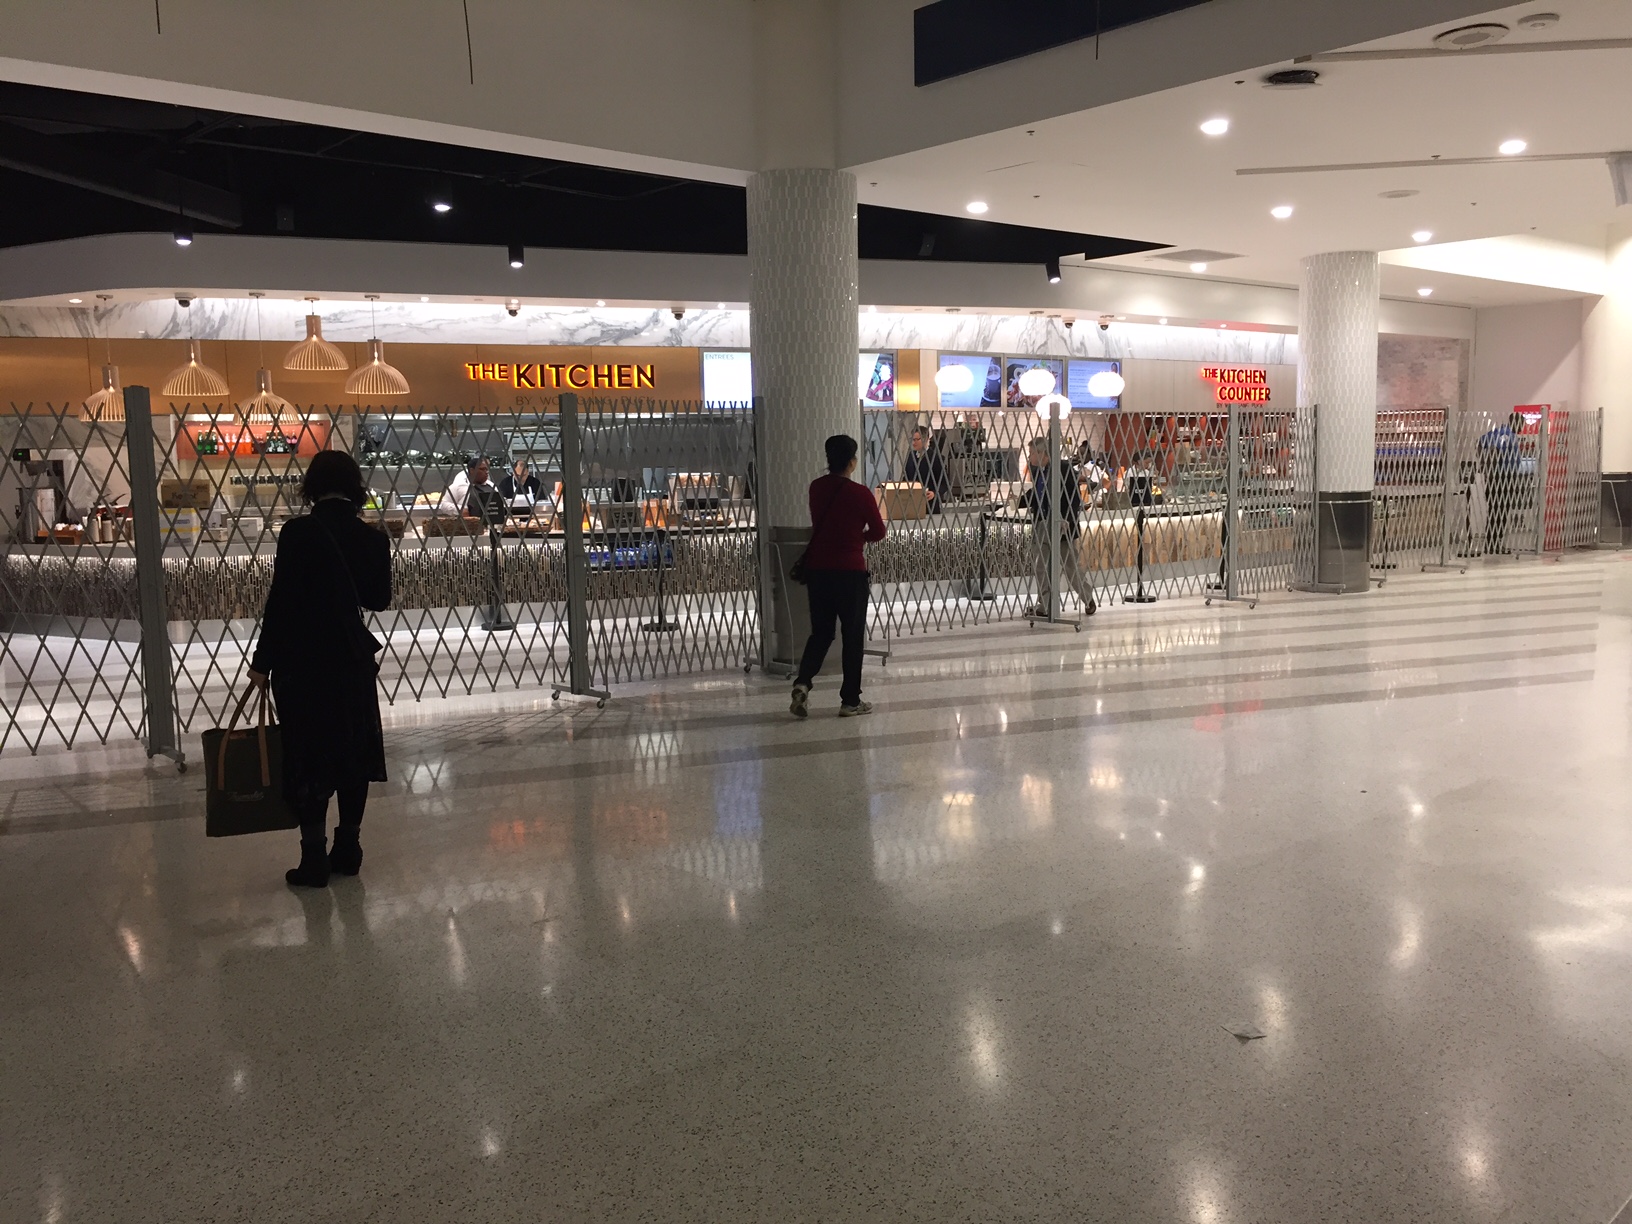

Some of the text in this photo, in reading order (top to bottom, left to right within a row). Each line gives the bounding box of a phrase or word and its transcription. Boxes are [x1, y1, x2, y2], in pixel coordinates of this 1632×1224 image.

[704, 353, 735, 361] ENTREES
[466, 363, 655, 389] THE KITCHEN
[1203, 368, 1266, 384] THE KITCHEN
[516, 396, 532, 406] BY
[1218, 386, 1271, 401] COUNTER
